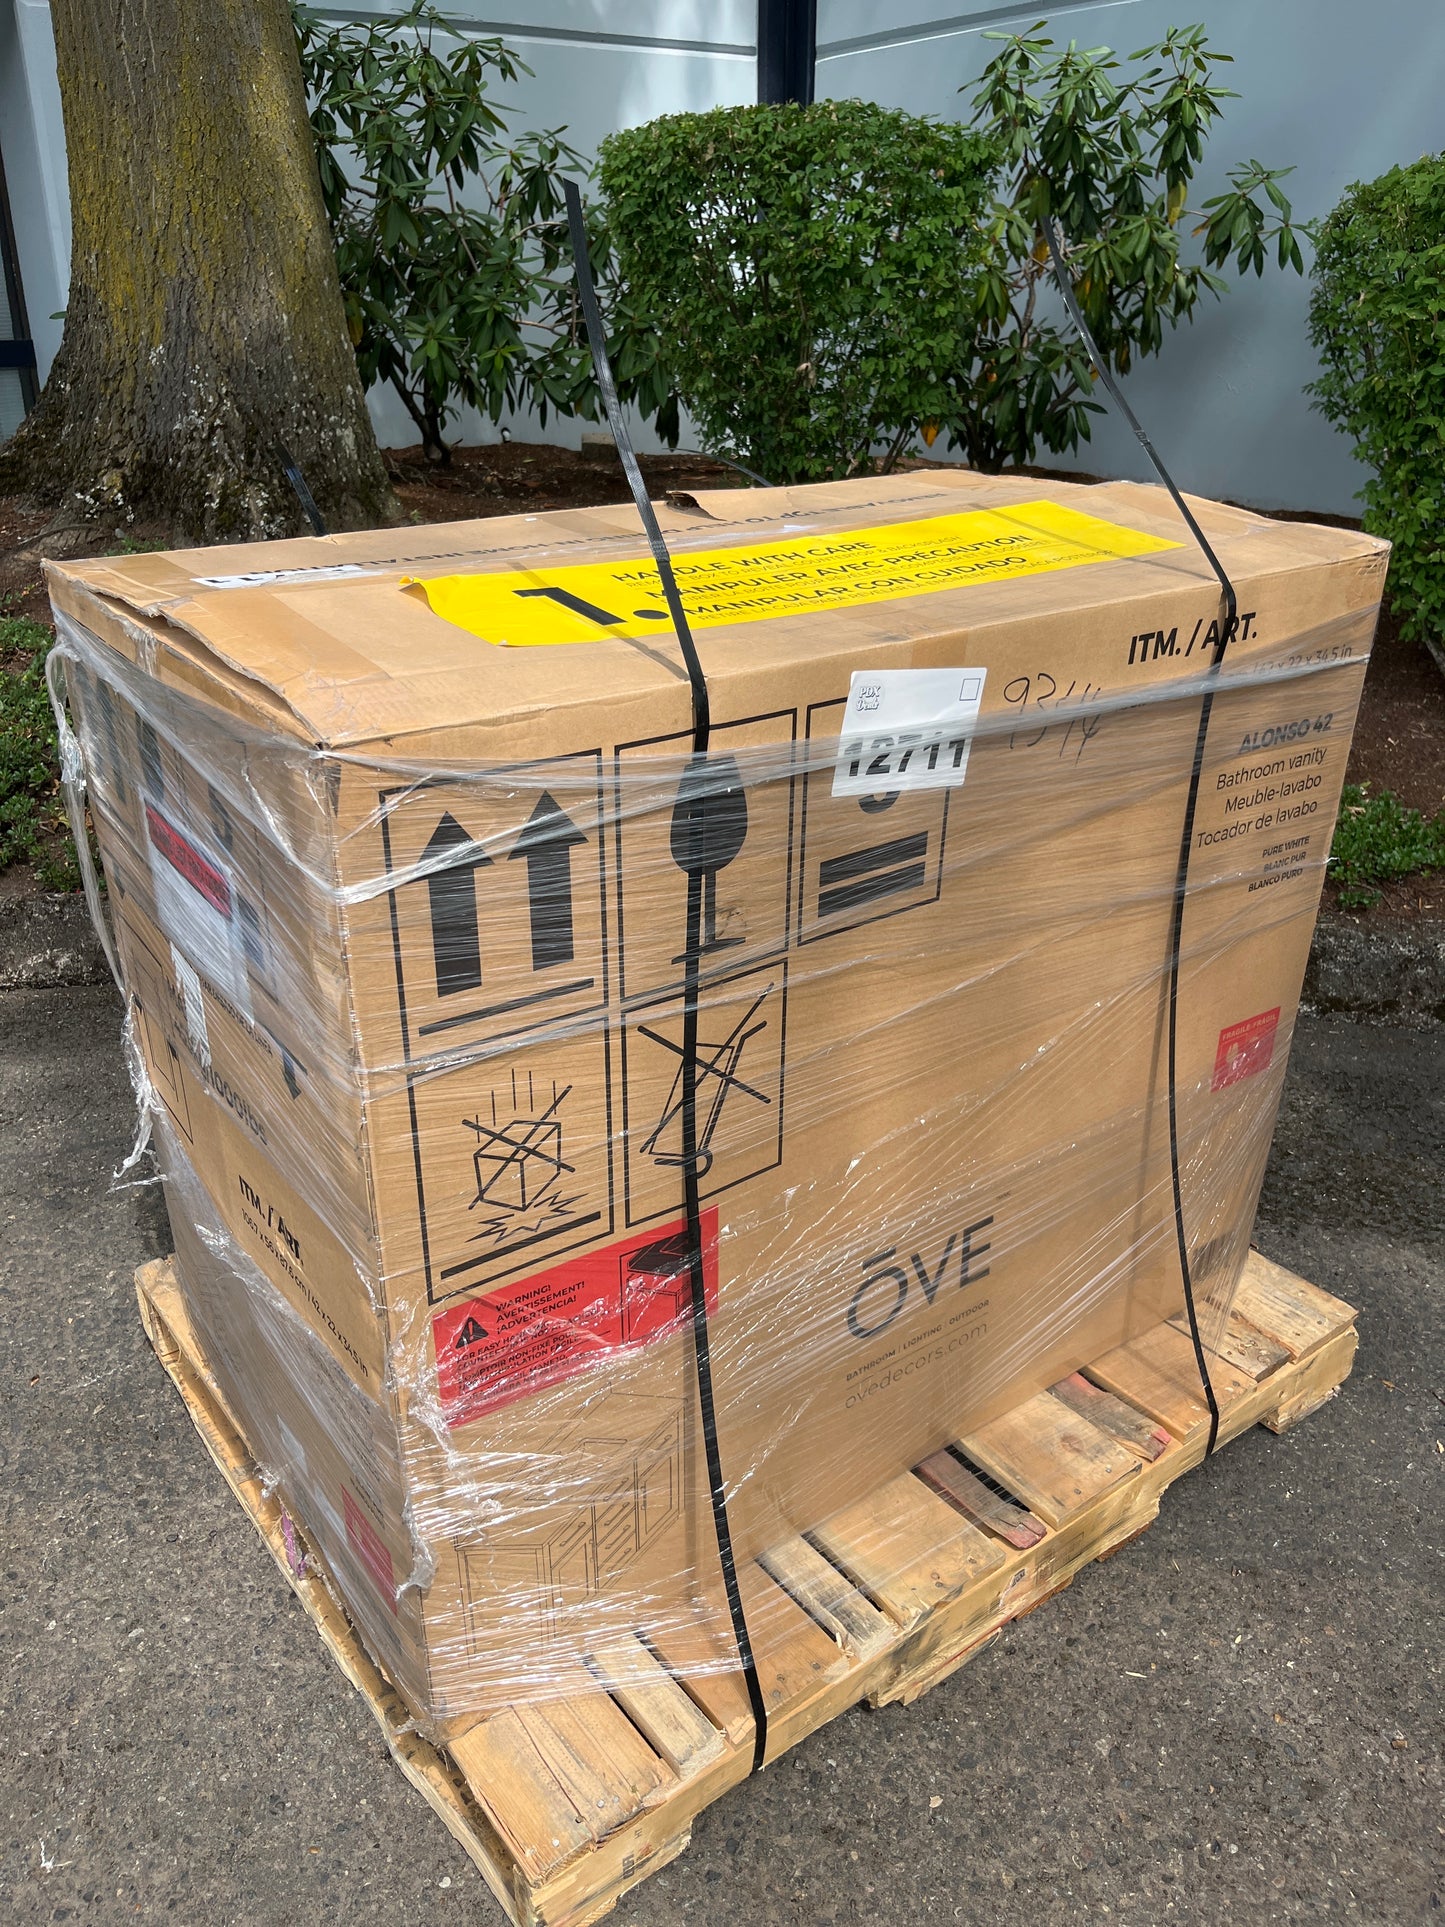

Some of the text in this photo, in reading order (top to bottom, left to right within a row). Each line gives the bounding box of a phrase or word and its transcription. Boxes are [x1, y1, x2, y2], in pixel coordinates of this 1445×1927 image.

[610, 541, 878, 581] HANDLE WITH CARE
[740, 562, 791, 574] REVEAL
[791, 549, 874, 566] COUNTERTOP
[887, 535, 962, 551] BACKSPLASH
[809, 560, 887, 576] AVEC
[879, 534, 1034, 564] PRÉCAUTION
[680, 556, 1030, 615] MANIPULAR CON CUIDADO
[1128, 628, 1181, 665] ITM.
[1202, 612, 1257, 651] ART.
[860, 686, 881, 699] PDX
[1238, 712, 1333, 755] ALONSO 42
[1217, 748, 1328, 791] Bathroom vanity
[1224, 773, 1322, 815] Meuble-lavabo
[1197, 798, 1318, 848] Tocador de lavabo
[1262, 836, 1310, 858] PURE WHITE
[1264, 852, 1306, 872] BLANC PUR
[1248, 868, 1303, 892] BLANCO PURO
[1223, 1024, 1250, 1041] FRAGILE
[238, 1175, 266, 1219] ITM.
[278, 1216, 304, 1266] ART.
[294, 1277, 307, 1296] cm
[311, 1296, 320, 1314] 42
[327, 1316, 337, 1334] 22
[496, 1285, 551, 1312] WARNING!
[496, 1281, 585, 1323] AVERTISSEMENT!
[496, 1295, 577, 1335] ¡ADVERTENCIA!
[478, 1340, 500, 1358] EASY
[846, 1300, 989, 1382] BATHROOM LIGHTING OUTDOOR
[845, 1322, 989, 1409] ovedecors.com
